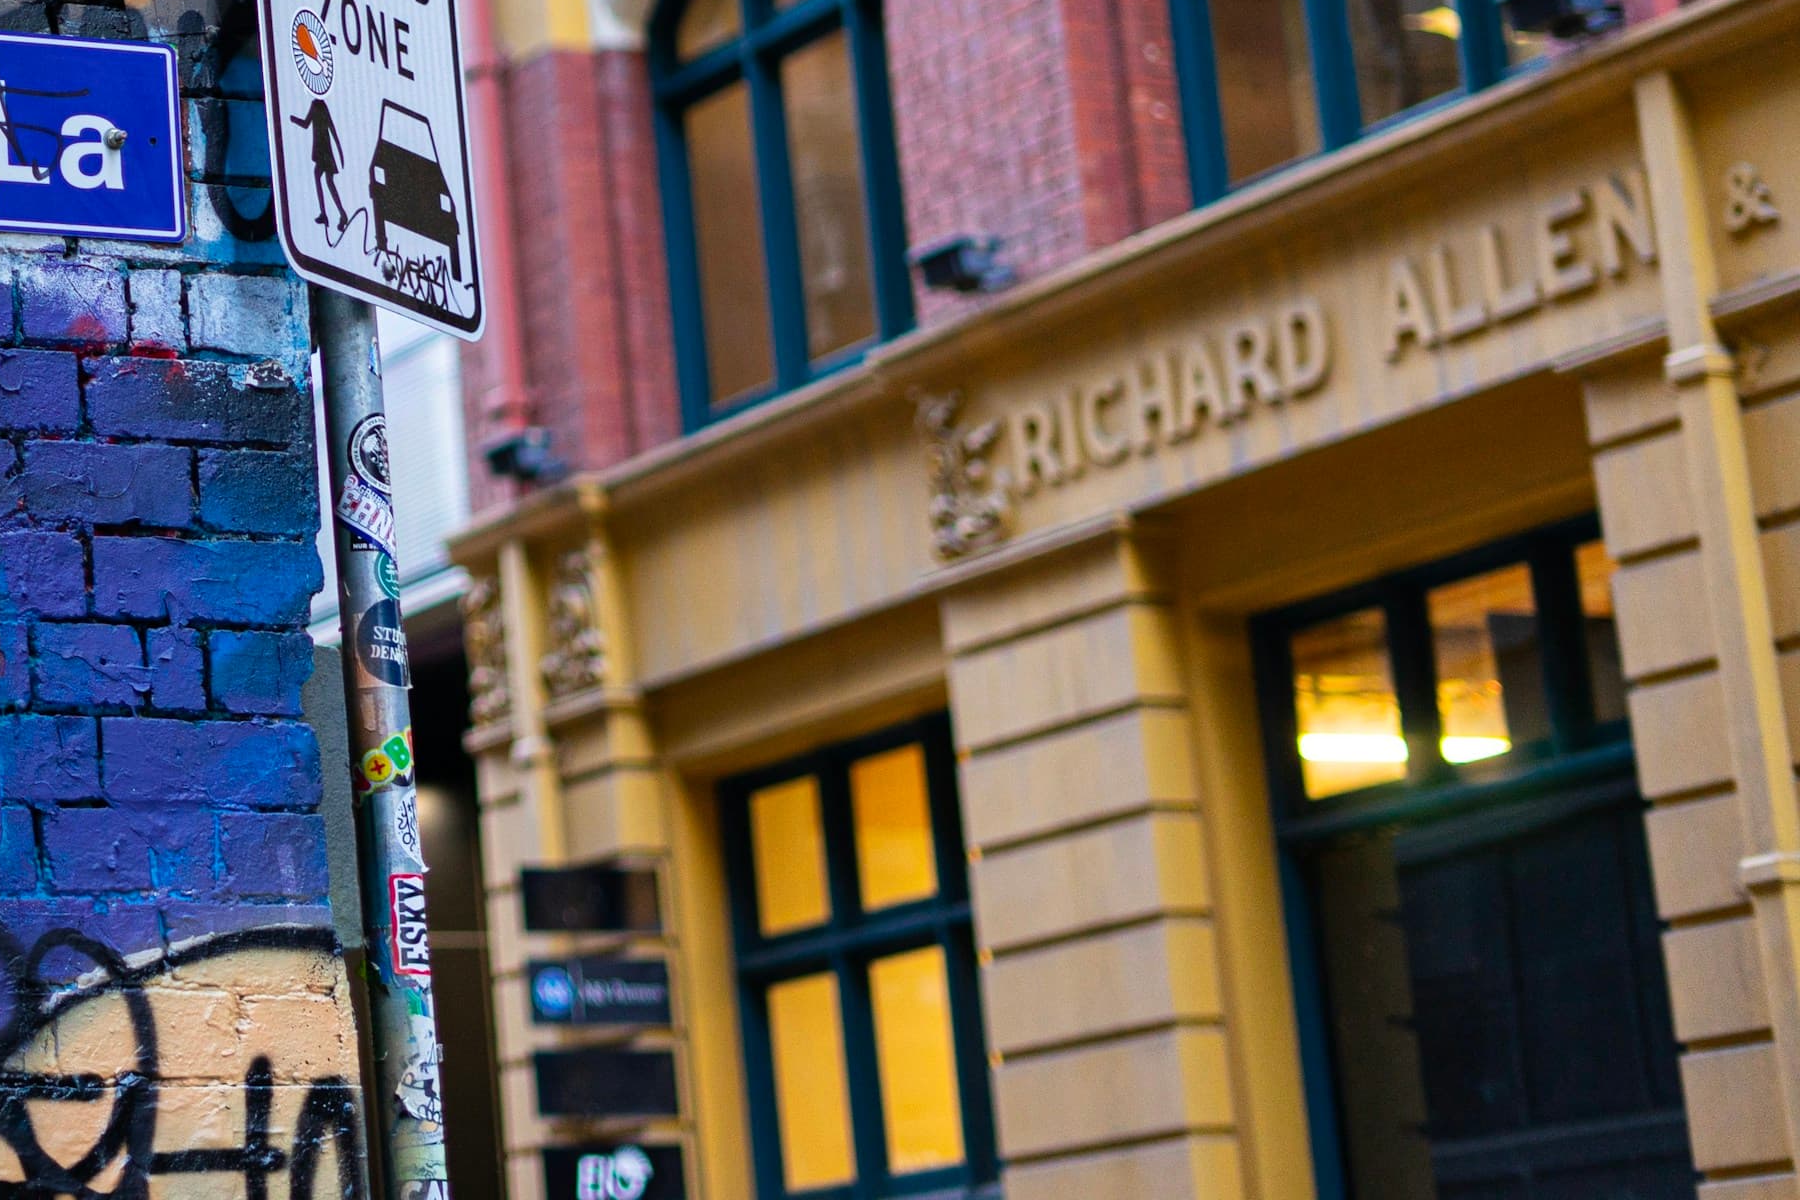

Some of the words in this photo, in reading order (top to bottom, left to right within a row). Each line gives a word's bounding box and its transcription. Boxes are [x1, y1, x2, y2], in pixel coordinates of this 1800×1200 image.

[1009, 298, 1334, 494] RICHARD
[1385, 167, 1659, 363] ALLEN
[1723, 161, 1781, 235] &
